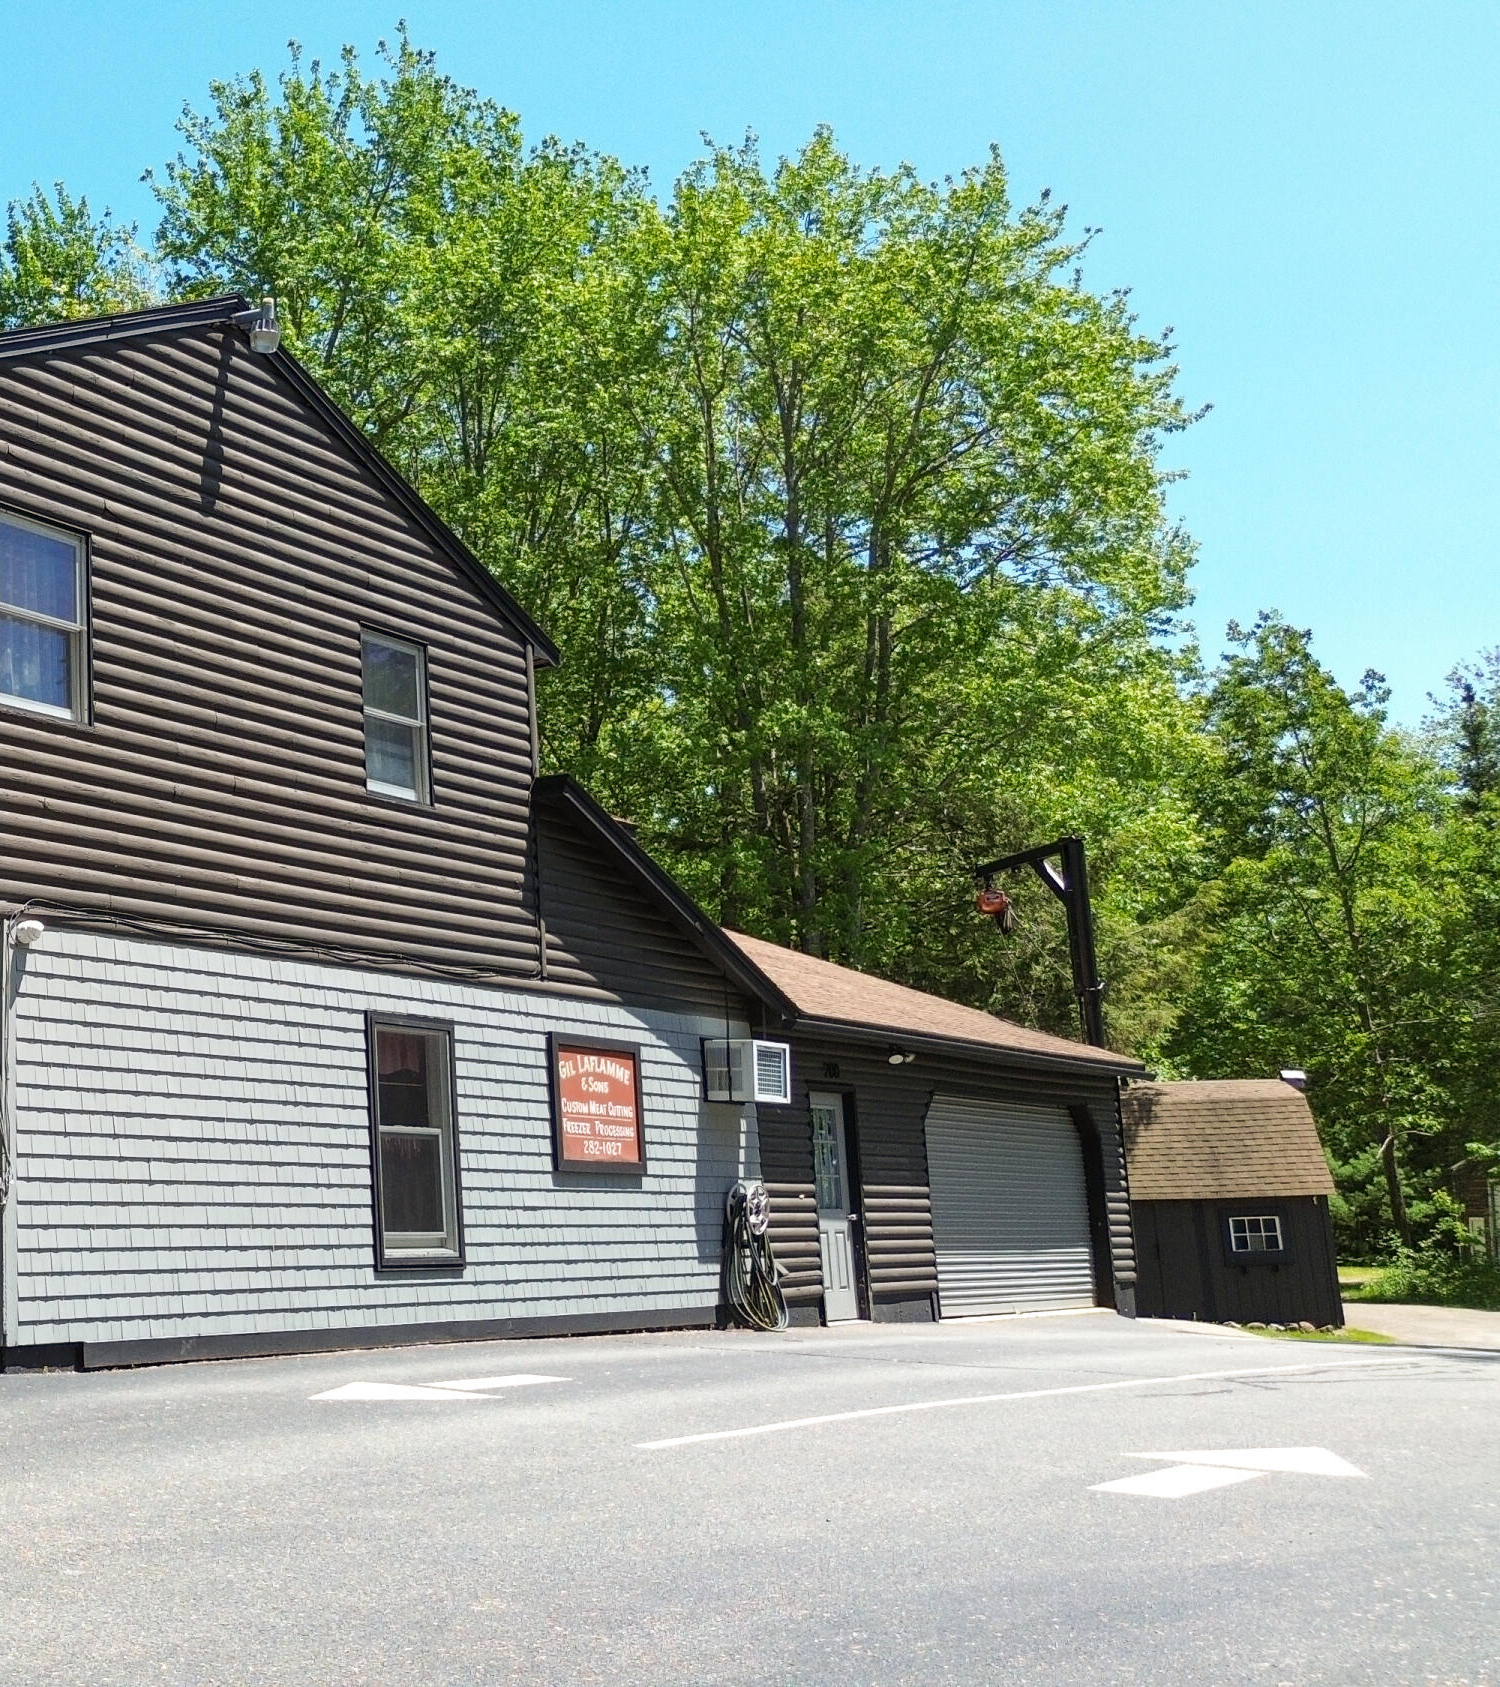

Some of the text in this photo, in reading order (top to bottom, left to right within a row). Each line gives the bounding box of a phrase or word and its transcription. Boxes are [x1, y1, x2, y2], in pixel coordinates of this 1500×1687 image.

[559, 1055, 631, 1086] GIL LAFLAMME
[562, 1097, 634, 1118] CUSTOM MEAT CUTTING
[562, 1117, 635, 1138] FREEZER PROCESSING
[583, 1140, 622, 1156] 282-1027
